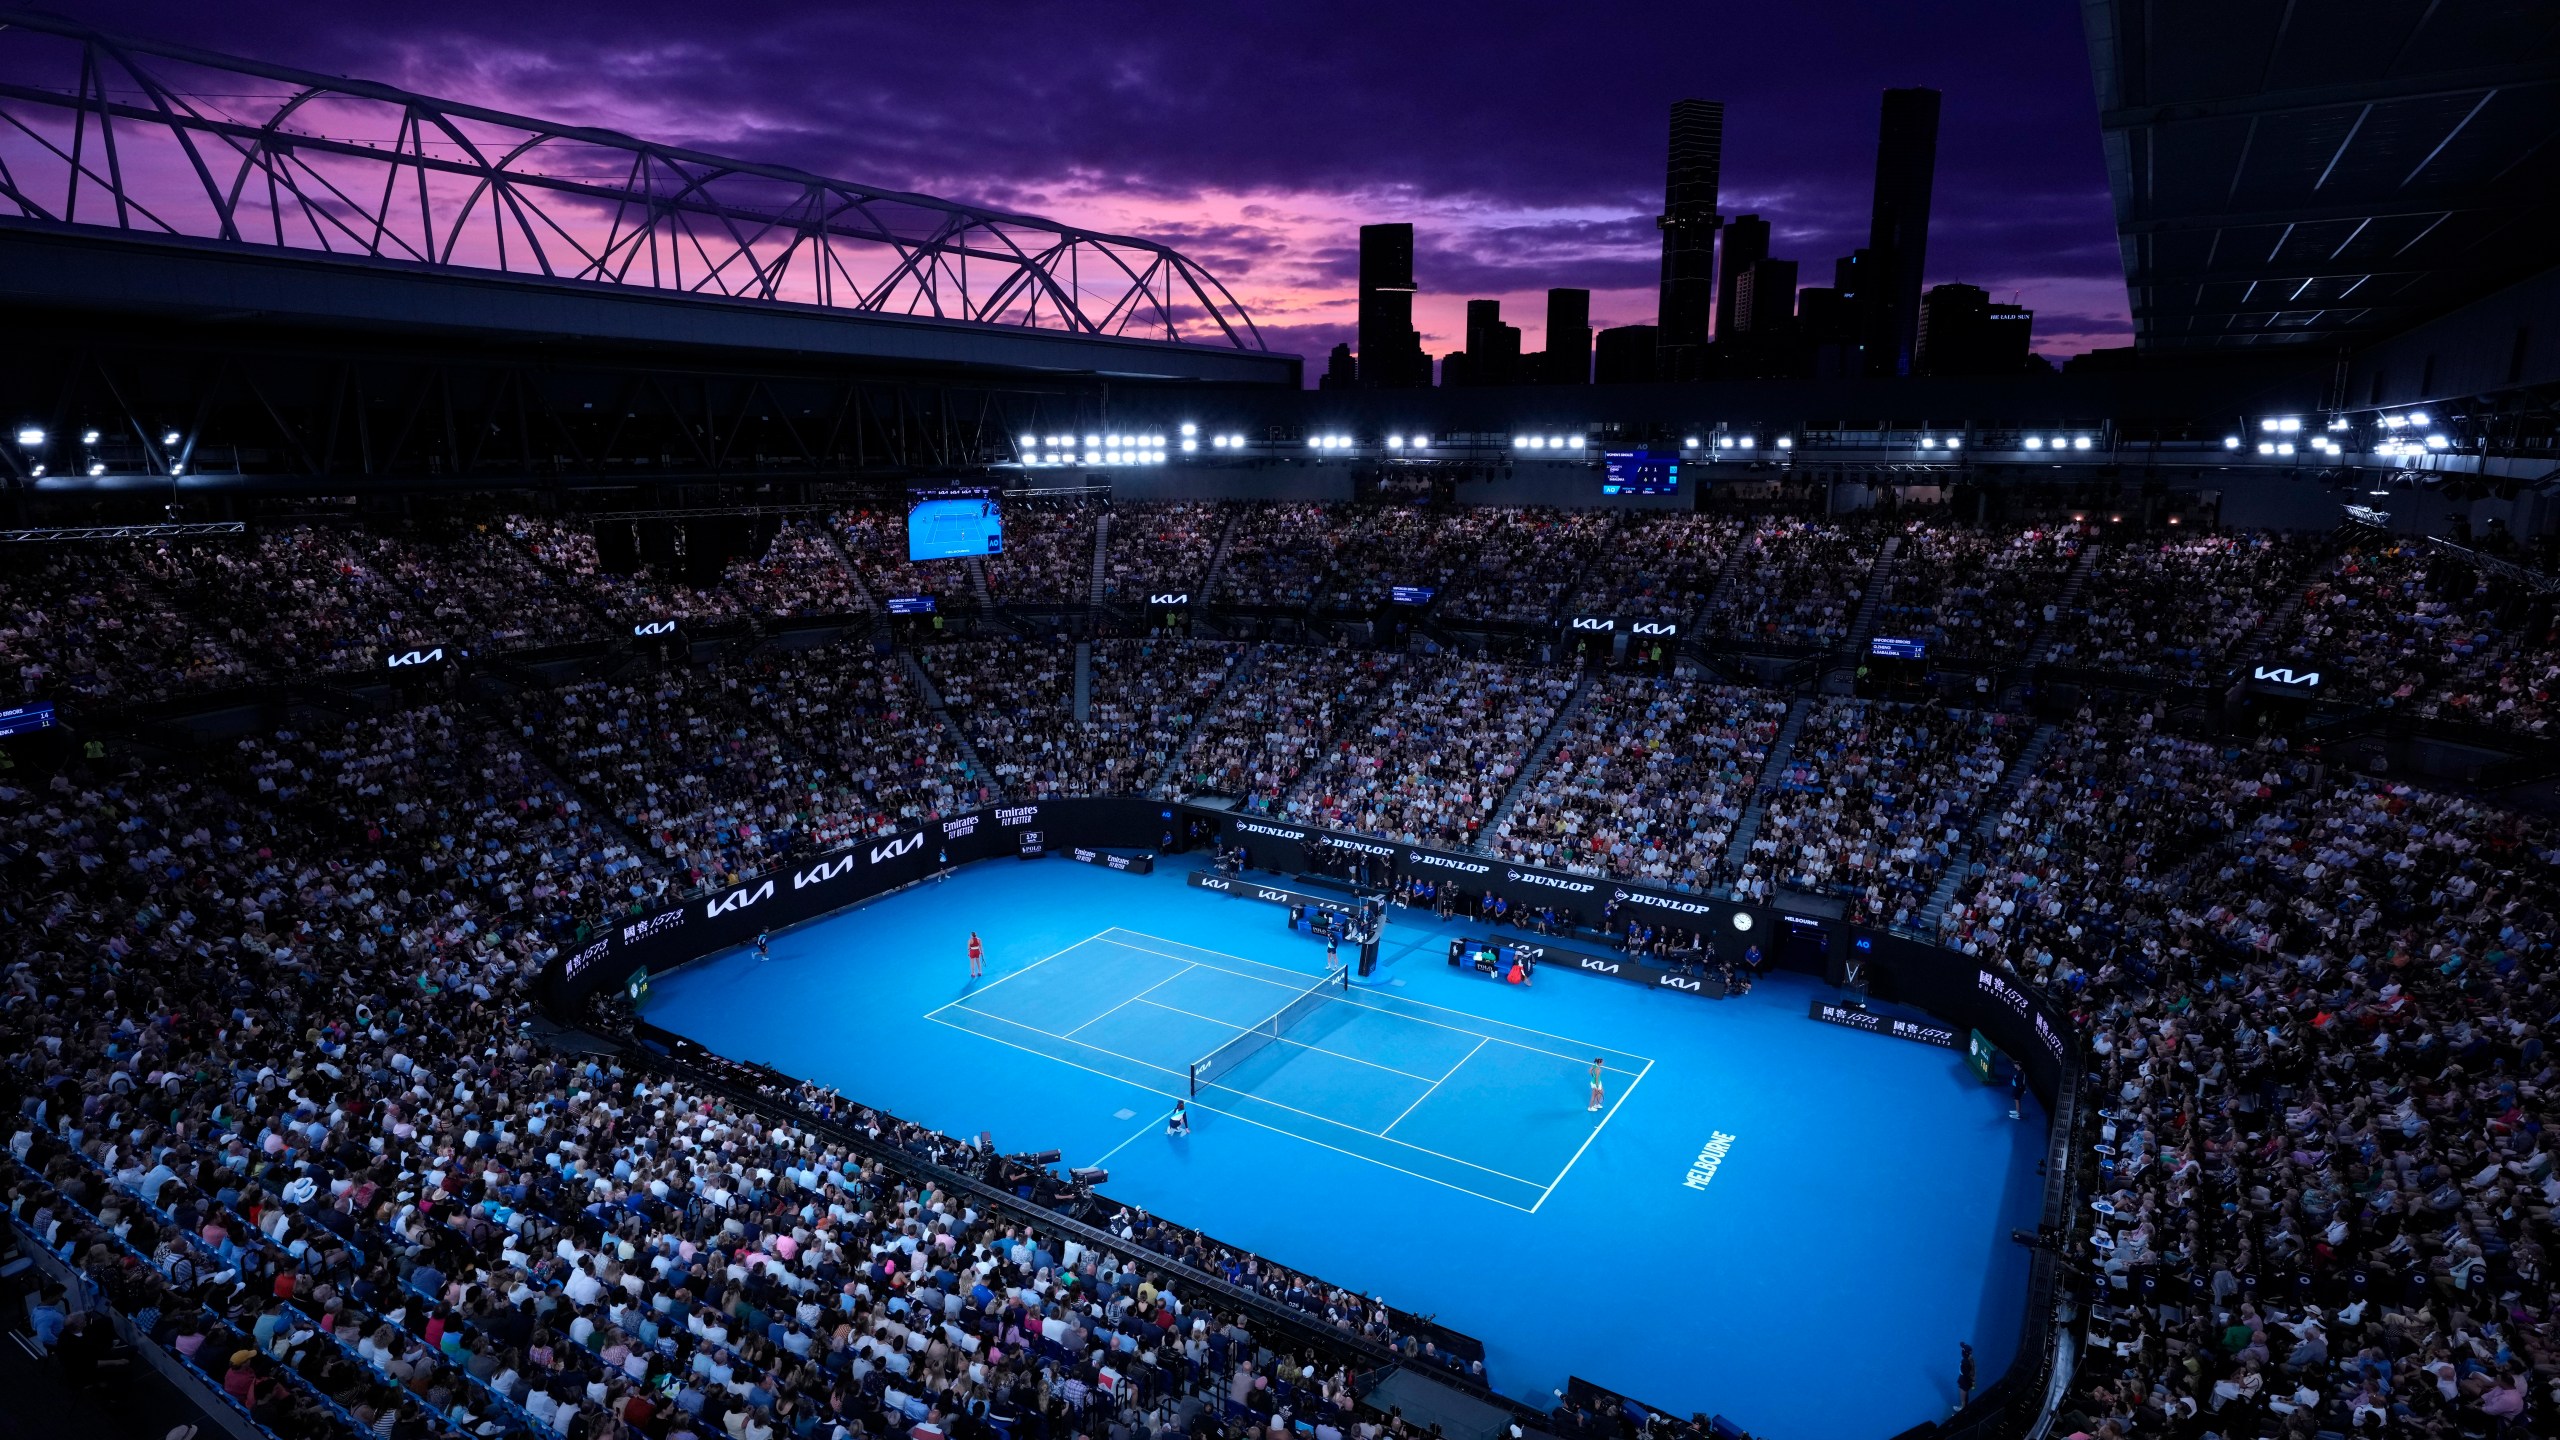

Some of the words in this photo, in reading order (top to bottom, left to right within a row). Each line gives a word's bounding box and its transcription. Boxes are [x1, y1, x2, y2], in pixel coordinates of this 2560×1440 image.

[1151, 594, 1188, 604] KIA
[635, 620, 675, 636] KIA
[1573, 618, 1614, 631] KIA
[1633, 622, 1676, 636] KIA
[388, 648, 443, 668] KIA
[2254, 665, 2319, 686] KIA
[3, 708, 24, 717] ERRORS
[40, 712, 49, 720] 14
[41, 720, 51, 728] 11
[995, 806, 1038, 819] Emirates
[943, 815, 979, 833] Emirates
[1001, 817, 1011, 827] FLY
[1012, 815, 1032, 825] BETTER
[948, 828, 956, 840] FLY
[956, 826, 974, 838] BETTER
[1247, 823, 1305, 840] DUNLOP
[871, 832, 924, 865] KIA
[1074, 848, 1096, 858] Emirates
[1107, 854, 1130, 866] Emirates
[1422, 855, 1490, 874] DUNLOP
[794, 854, 854, 890] KIA
[1202, 877, 1229, 890] KIA
[1521, 873, 1595, 893] DUNLOP
[707, 880, 775, 918] KIA
[1258, 889, 1288, 902] KIA
[1629, 893, 1710, 914] DUNLOP
[1784, 916, 1819, 927] MELBOURNE
[1856, 939, 1870, 949] AO
[1581, 958, 1619, 974] KIA
[1332, 972, 1345, 985] KIA
[1660, 975, 1700, 992] KIA
[1196, 1060, 1212, 1076] KIA
[1682, 1130, 1737, 1191] MELBOURNE
